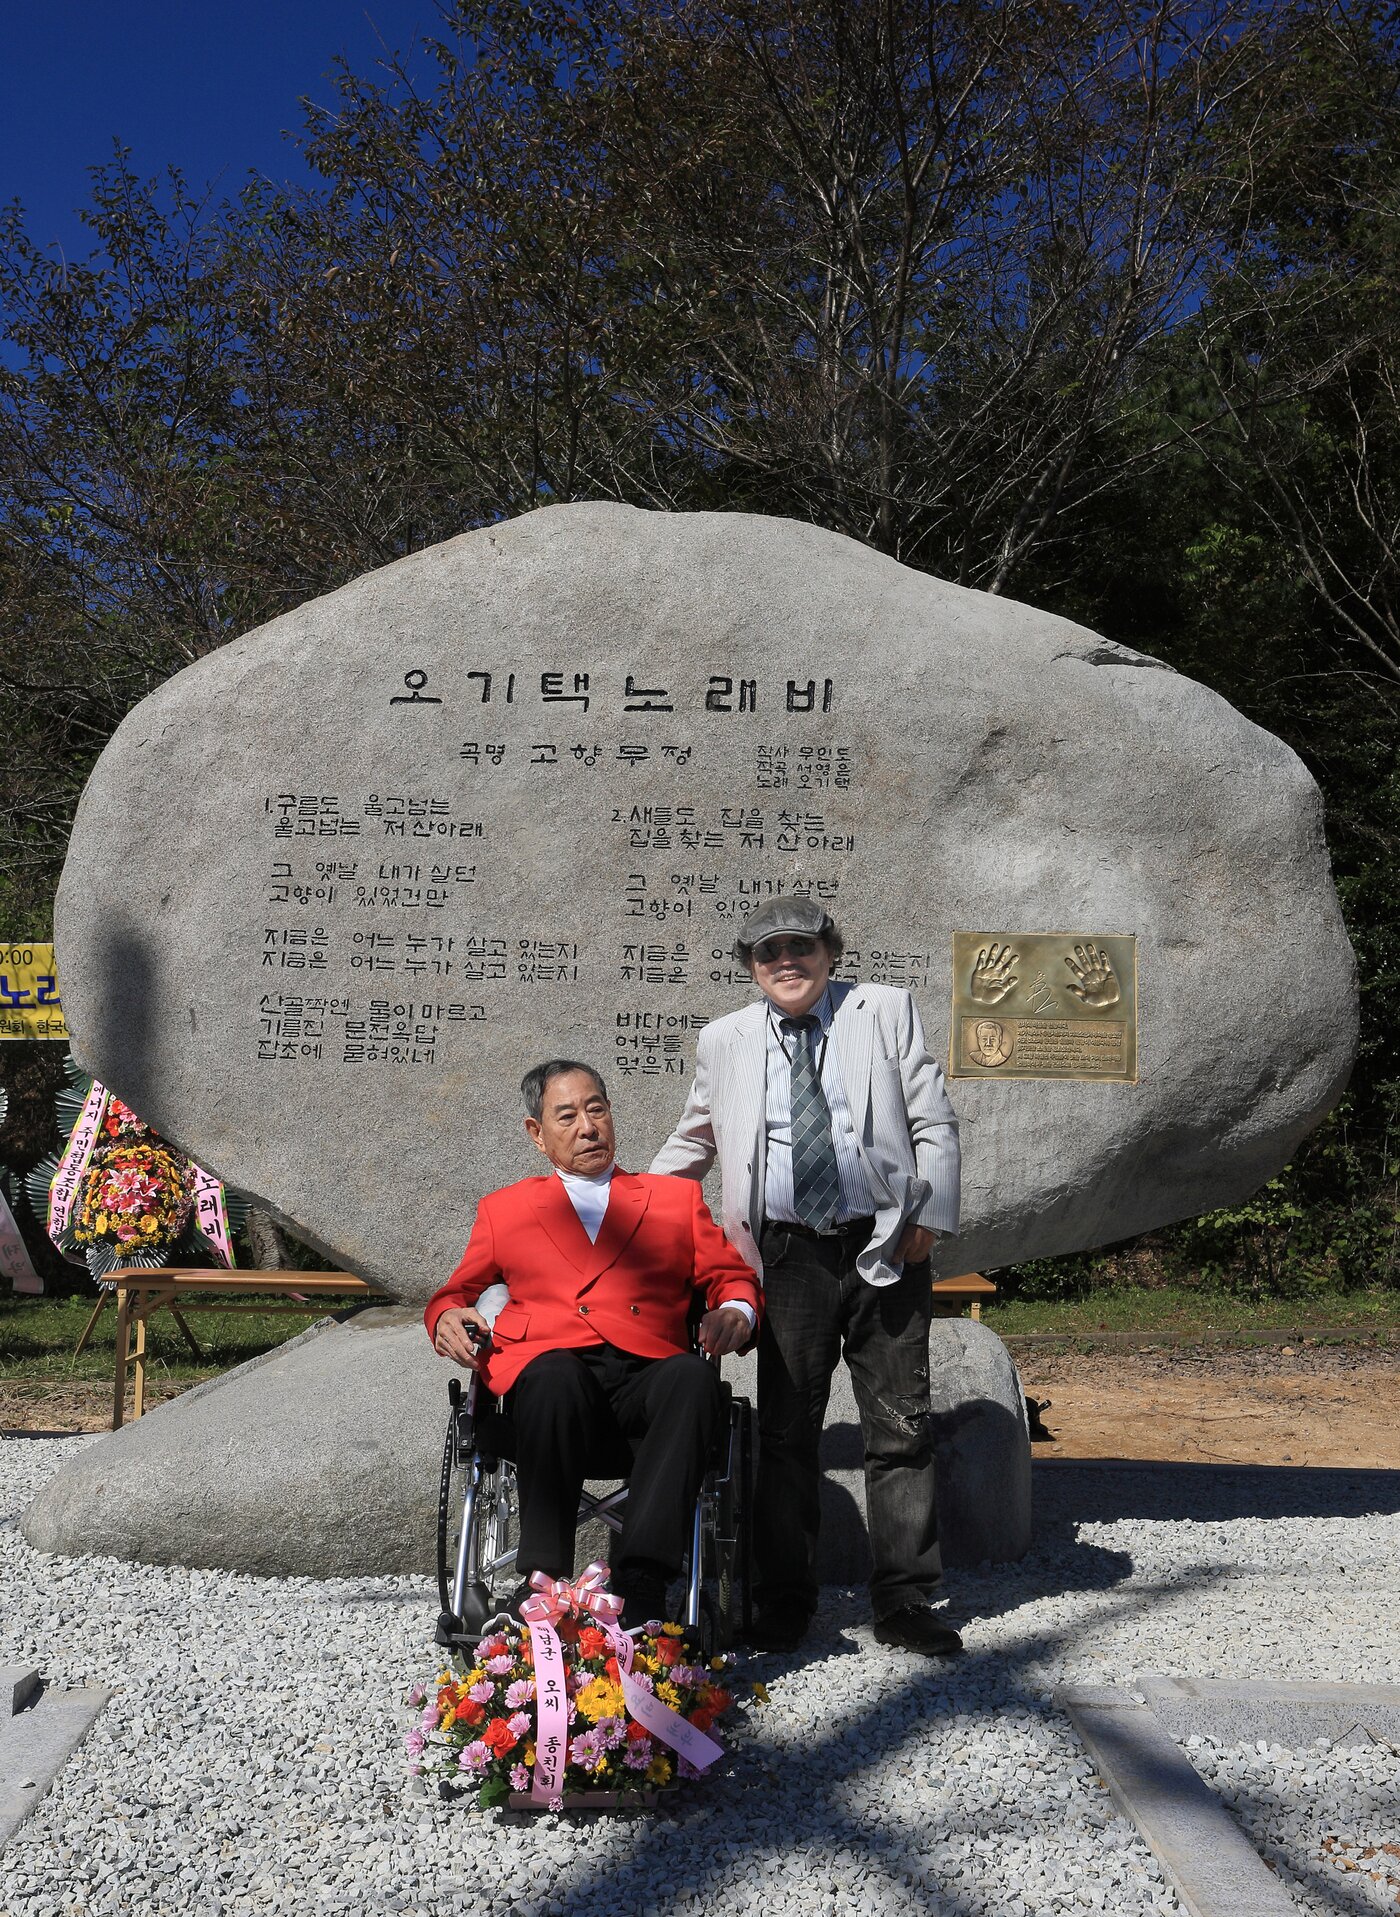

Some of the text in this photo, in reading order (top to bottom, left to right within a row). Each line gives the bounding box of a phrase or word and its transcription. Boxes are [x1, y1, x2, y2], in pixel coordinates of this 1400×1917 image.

[459, 742, 506, 765] 곡명
[757, 745, 789, 760] 작사
[757, 761, 788, 776] 작곡
[757, 774, 851, 791] 노래 오기택
[720, 808, 765, 829] 집을
[777, 809, 825, 832] 찾는
[629, 827, 672, 849] 집을
[679, 828, 725, 850] 찾는
[271, 862, 477, 884] 그 옛날 내가 살던
[268, 885, 450, 908] 고향이 있었건만
[624, 873, 839, 899] 그 옛날 내가 살던
[624, 898, 693, 921] 고향이
[264, 927, 578, 961] 지금은 어느 누가 살고 있는지
[622, 942, 690, 963] 지금은
[261, 950, 329, 970] 지금은
[350, 956, 396, 972] 어느
[404, 957, 454, 977] 누가
[463, 961, 507, 980] 살고
[619, 965, 688, 984] 지금은
[259, 994, 488, 1023] 산골짝엔 물이 마르고
[37, 1019, 68, 1034] 한국
[259, 1018, 440, 1044] 기름진 문전옥답
[615, 1012, 711, 1030] 바다에는
[257, 1040, 323, 1060] 잡초에
[615, 1034, 685, 1054] 어부들
